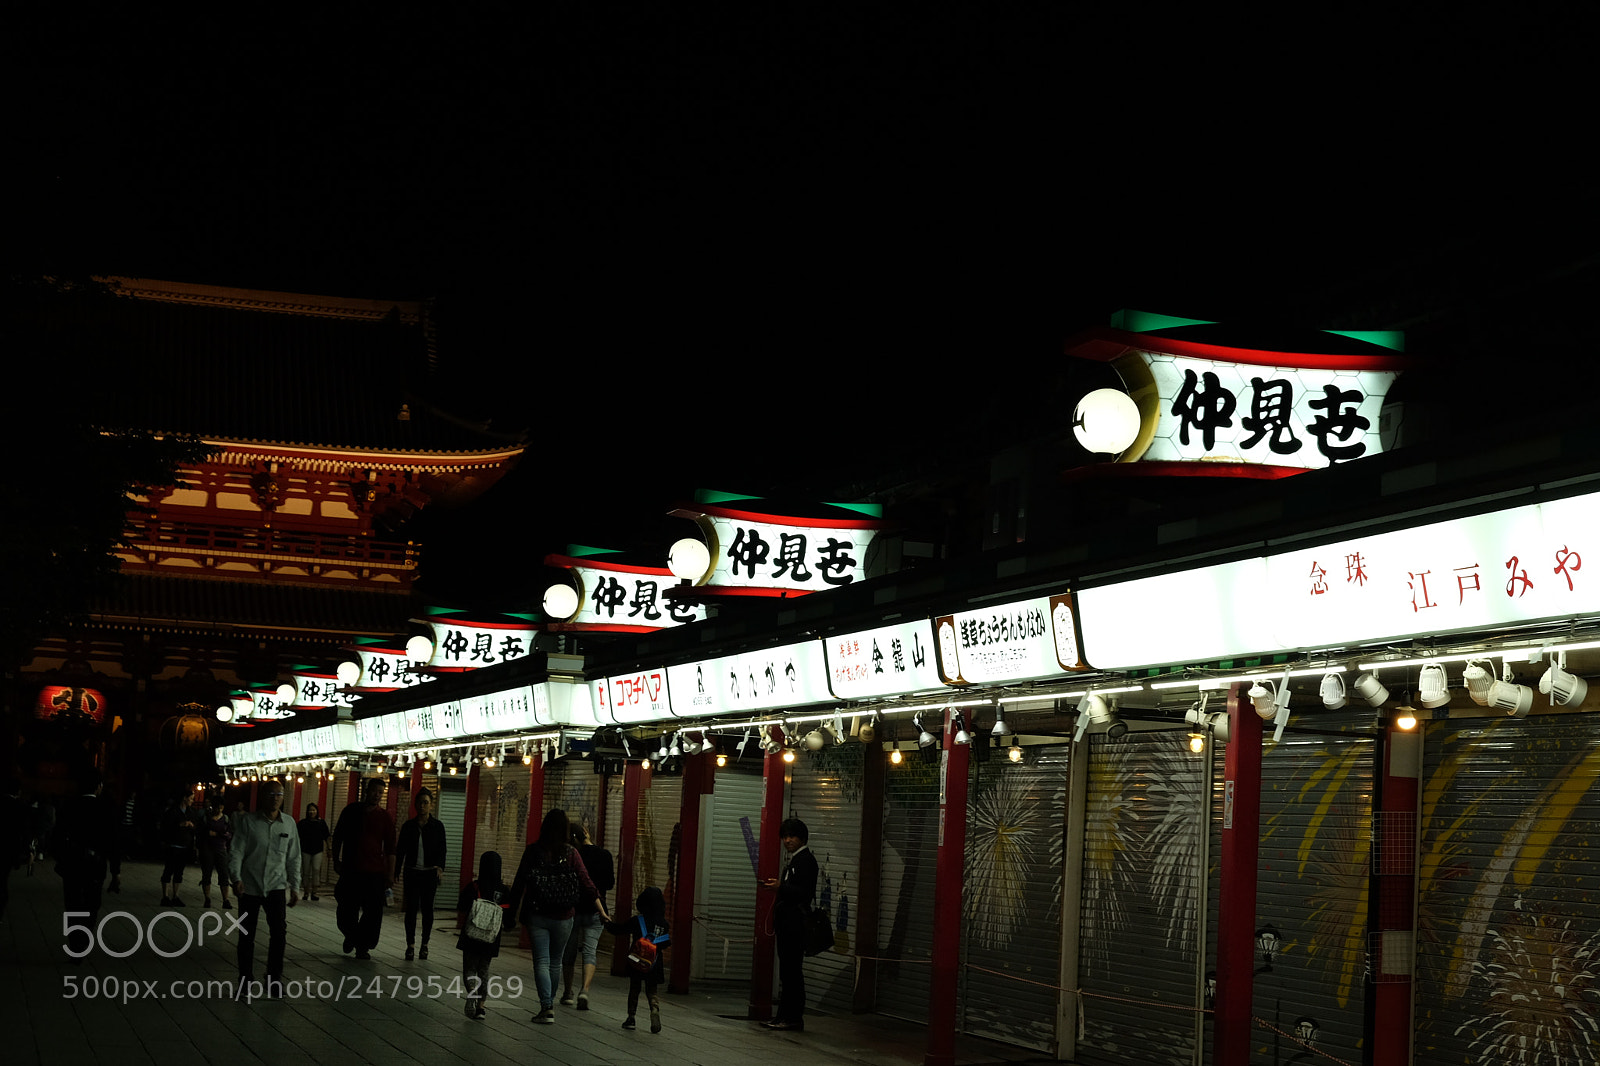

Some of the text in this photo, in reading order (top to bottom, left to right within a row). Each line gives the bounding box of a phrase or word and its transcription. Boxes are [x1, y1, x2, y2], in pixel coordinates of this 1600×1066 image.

[1171, 369, 1370, 465] 仲見世
[727, 527, 856, 585] 仲見世
[1407, 544, 1582, 613] 江戸みや
[871, 631, 926, 674] 金龍山
[615, 673, 661, 706] コマチヘア
